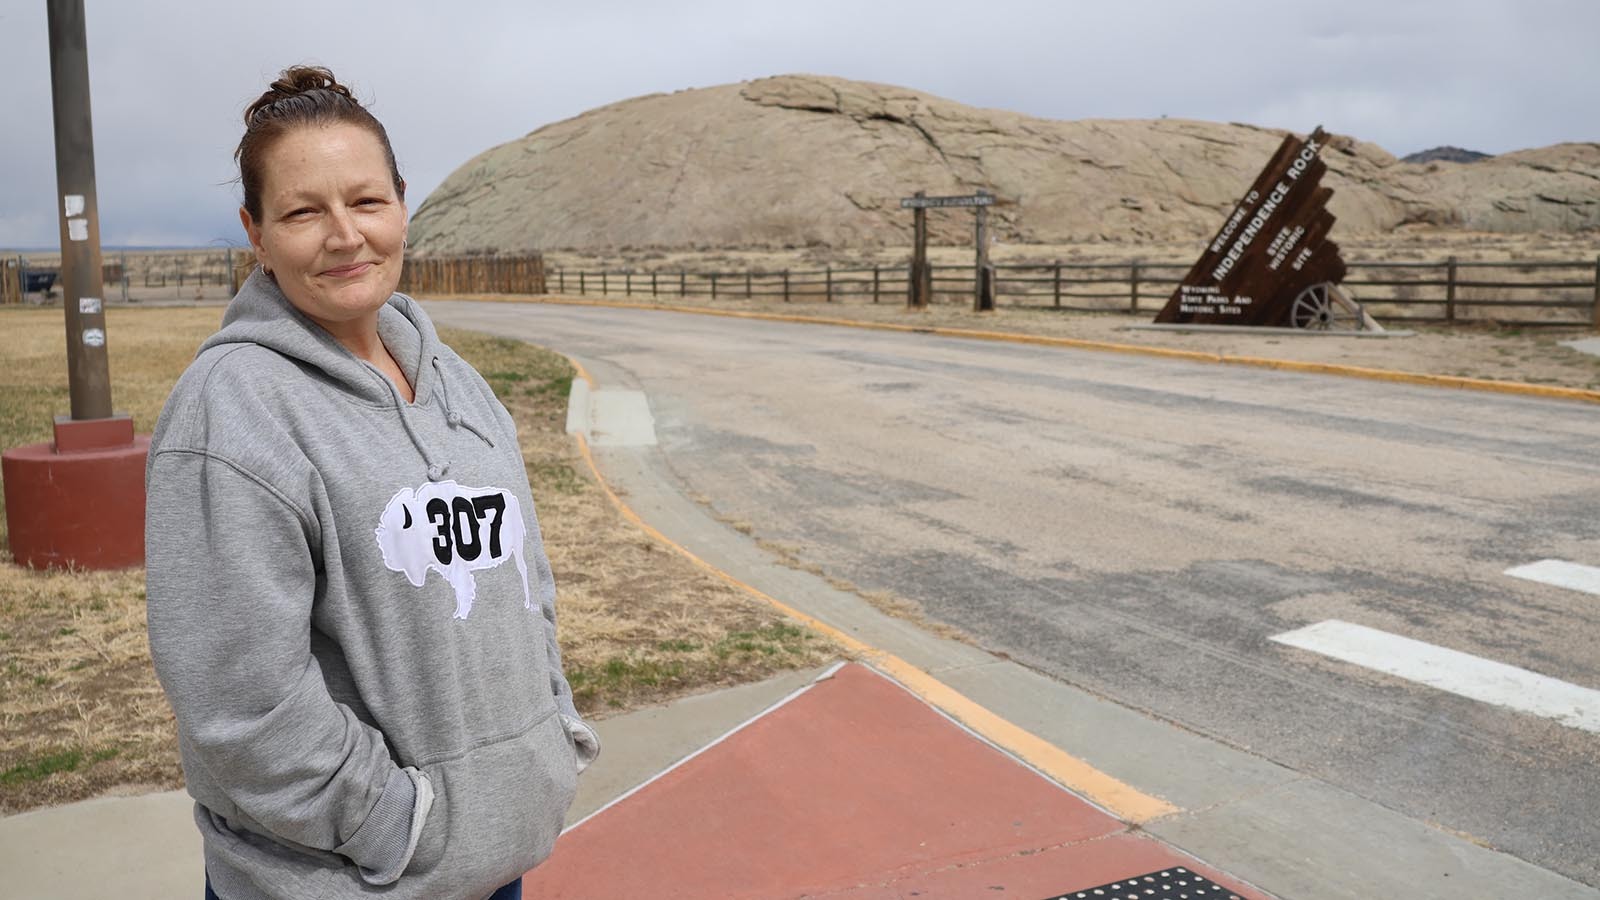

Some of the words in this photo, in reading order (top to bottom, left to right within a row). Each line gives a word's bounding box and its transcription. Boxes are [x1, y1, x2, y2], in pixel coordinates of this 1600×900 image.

[1211, 208, 1246, 253] WELCOME
[1247, 190, 1260, 205] TO
[1213, 182, 1290, 281] INDEPENDENCE
[1286, 140, 1321, 179] ROCK
[1266, 227, 1291, 257] STATE
[1270, 226, 1305, 271] HISTORIC
[1293, 248, 1312, 271] SITE
[426, 493, 506, 565] 307
